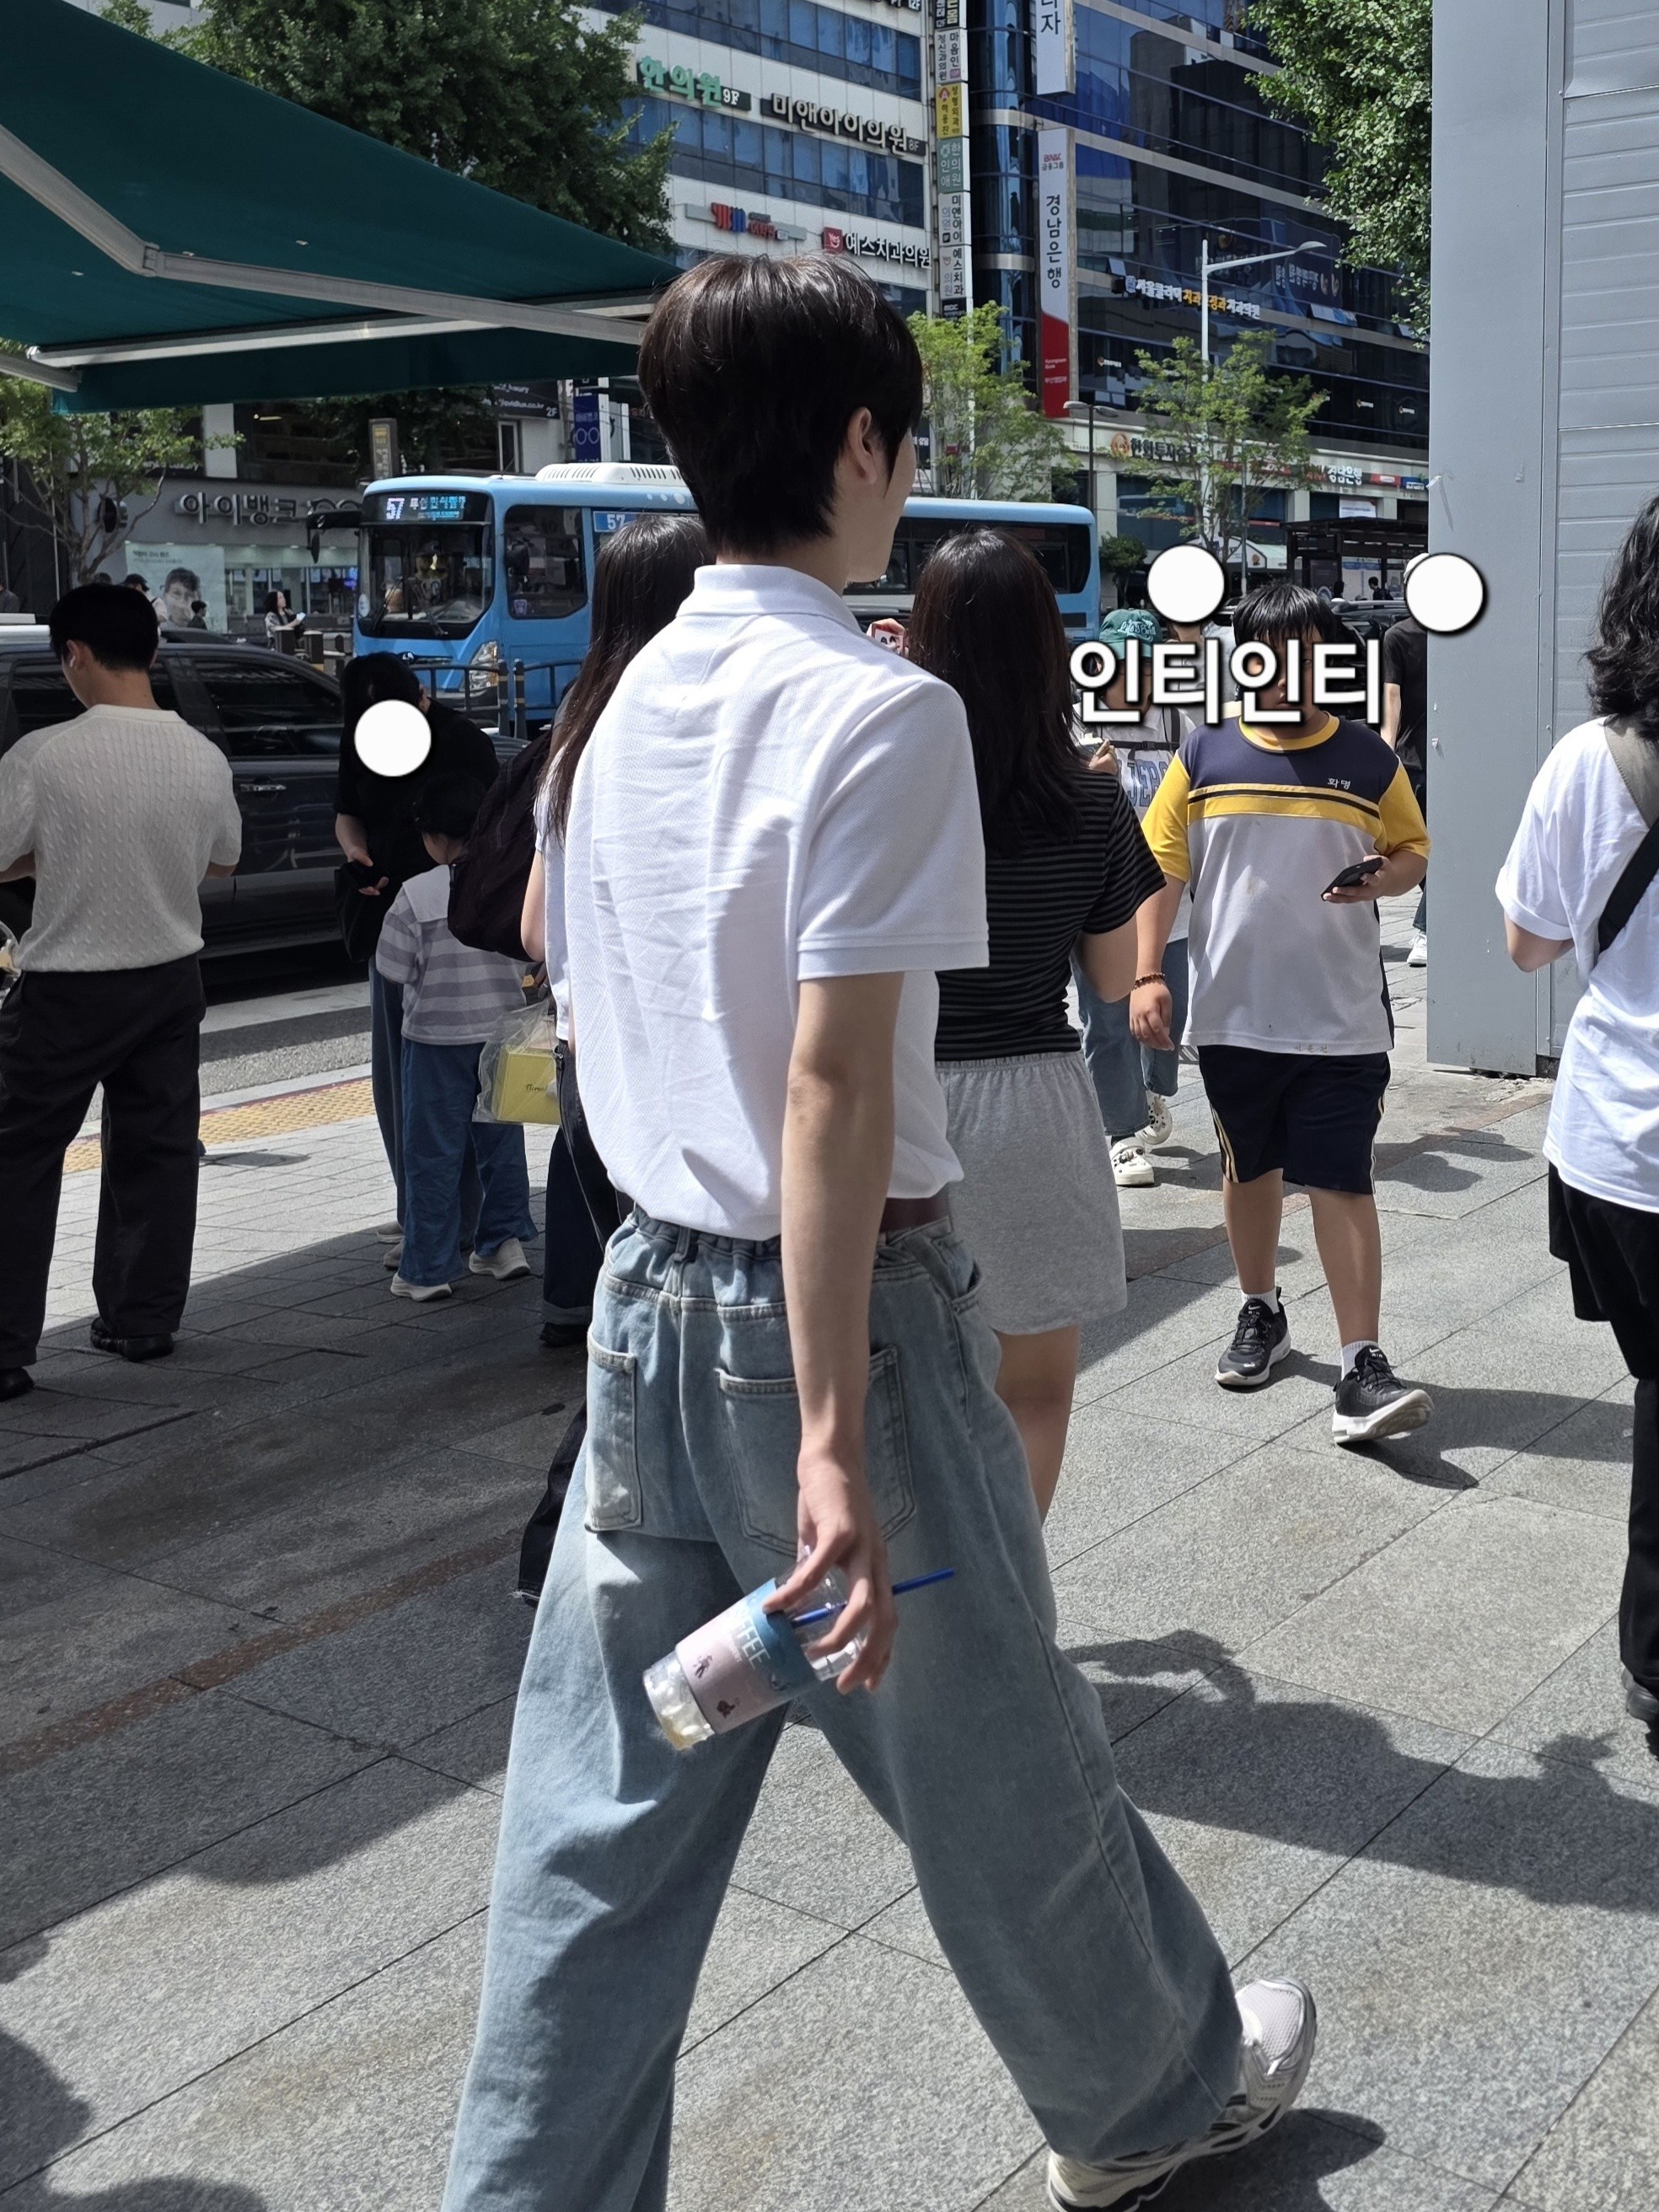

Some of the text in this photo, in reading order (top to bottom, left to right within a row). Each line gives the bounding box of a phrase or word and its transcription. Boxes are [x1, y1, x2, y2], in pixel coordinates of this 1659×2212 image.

[640, 56, 740, 108] 한의원 9F
[771, 93, 920, 157] 미앤아이의원 8F
[952, 195, 962, 242] 미앤아이
[846, 232, 932, 270] 예스치과의원
[1046, 194, 1062, 288] 경남은행
[953, 248, 964, 295] 예스치과
[1328, 464, 1362, 486] 경남은행
[180, 491, 299, 527] 아이뱅크
[386, 497, 405, 519] 57
[607, 513, 625, 530] 57
[1328, 777, 1351, 790] 화명
